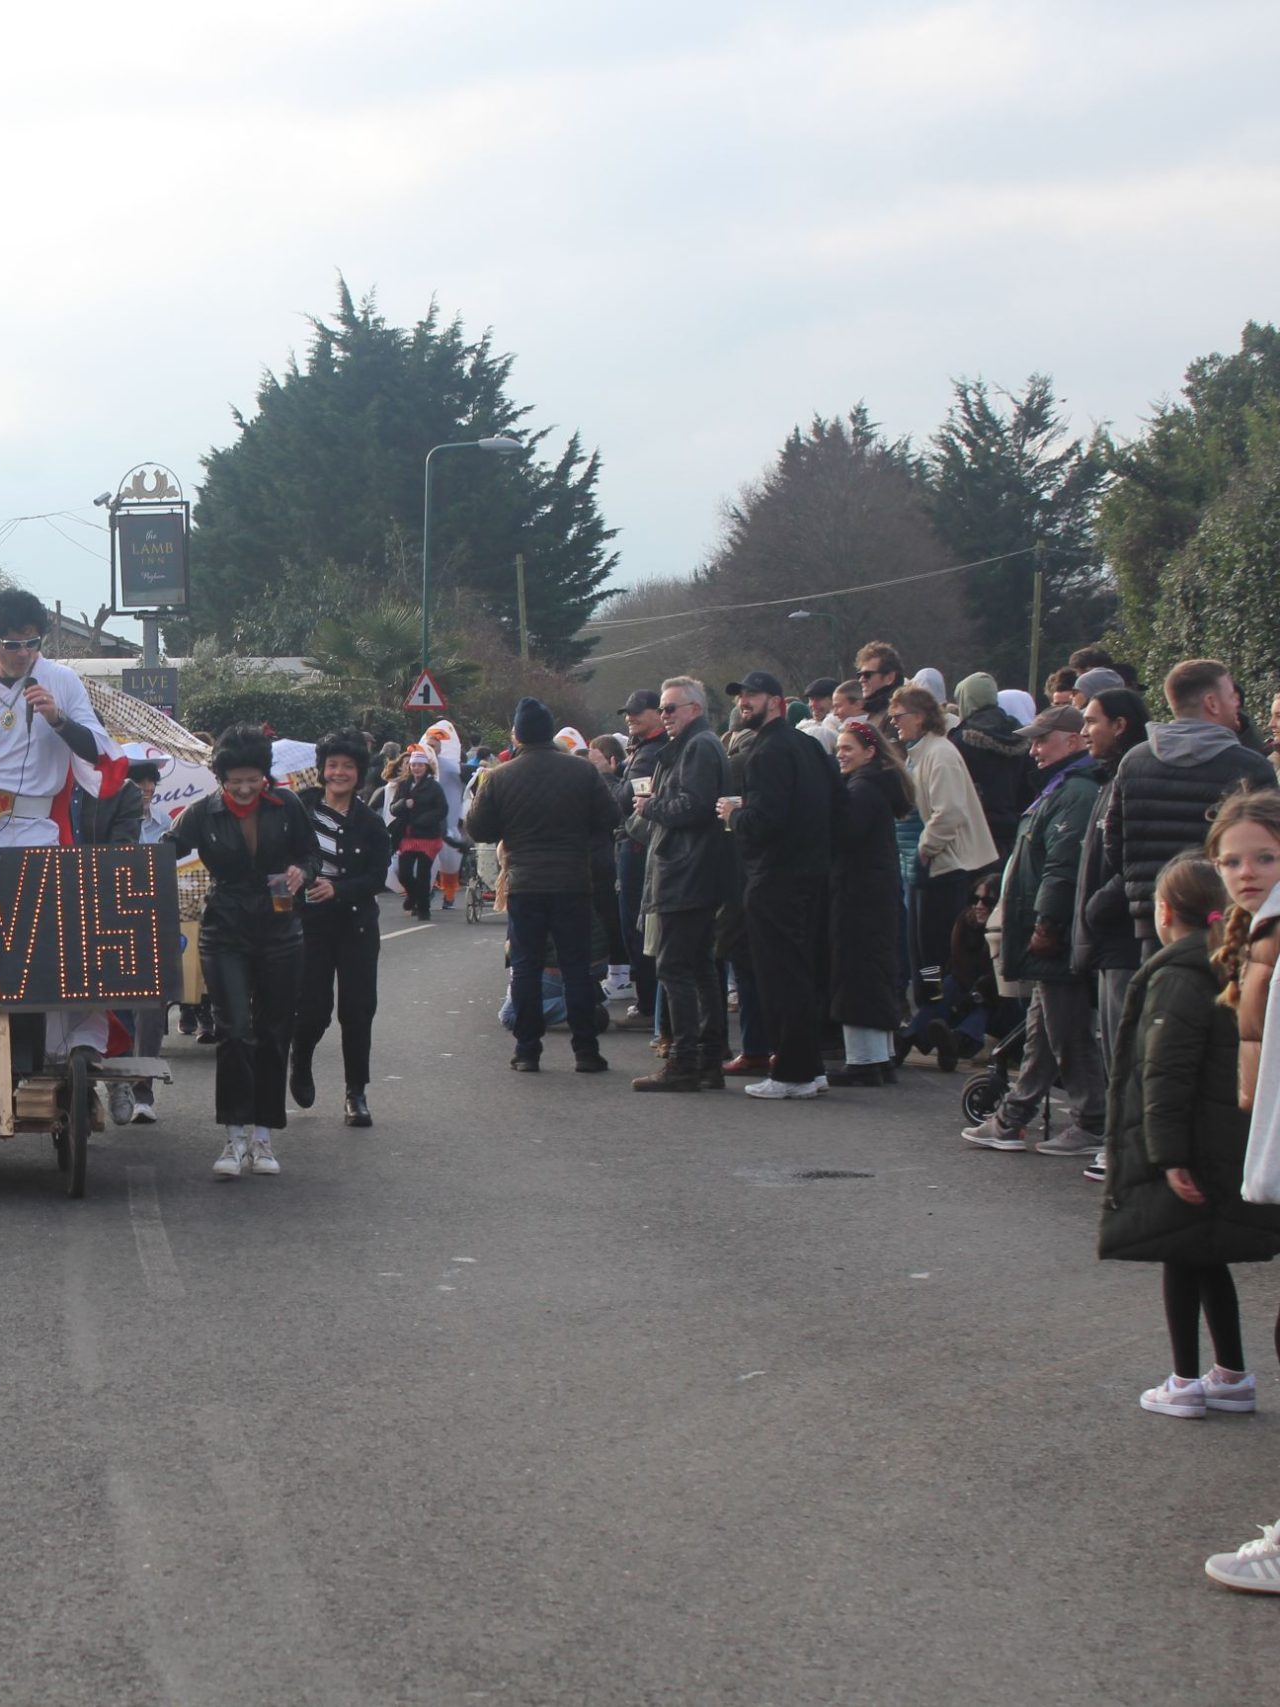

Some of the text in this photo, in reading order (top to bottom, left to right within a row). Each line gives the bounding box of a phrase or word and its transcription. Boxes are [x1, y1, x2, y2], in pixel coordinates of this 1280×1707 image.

[132, 543, 175, 555] LAMB
[142, 558, 166, 566] INN
[132, 675, 169, 688] LIVE
[142, 695, 165, 704] AMB
